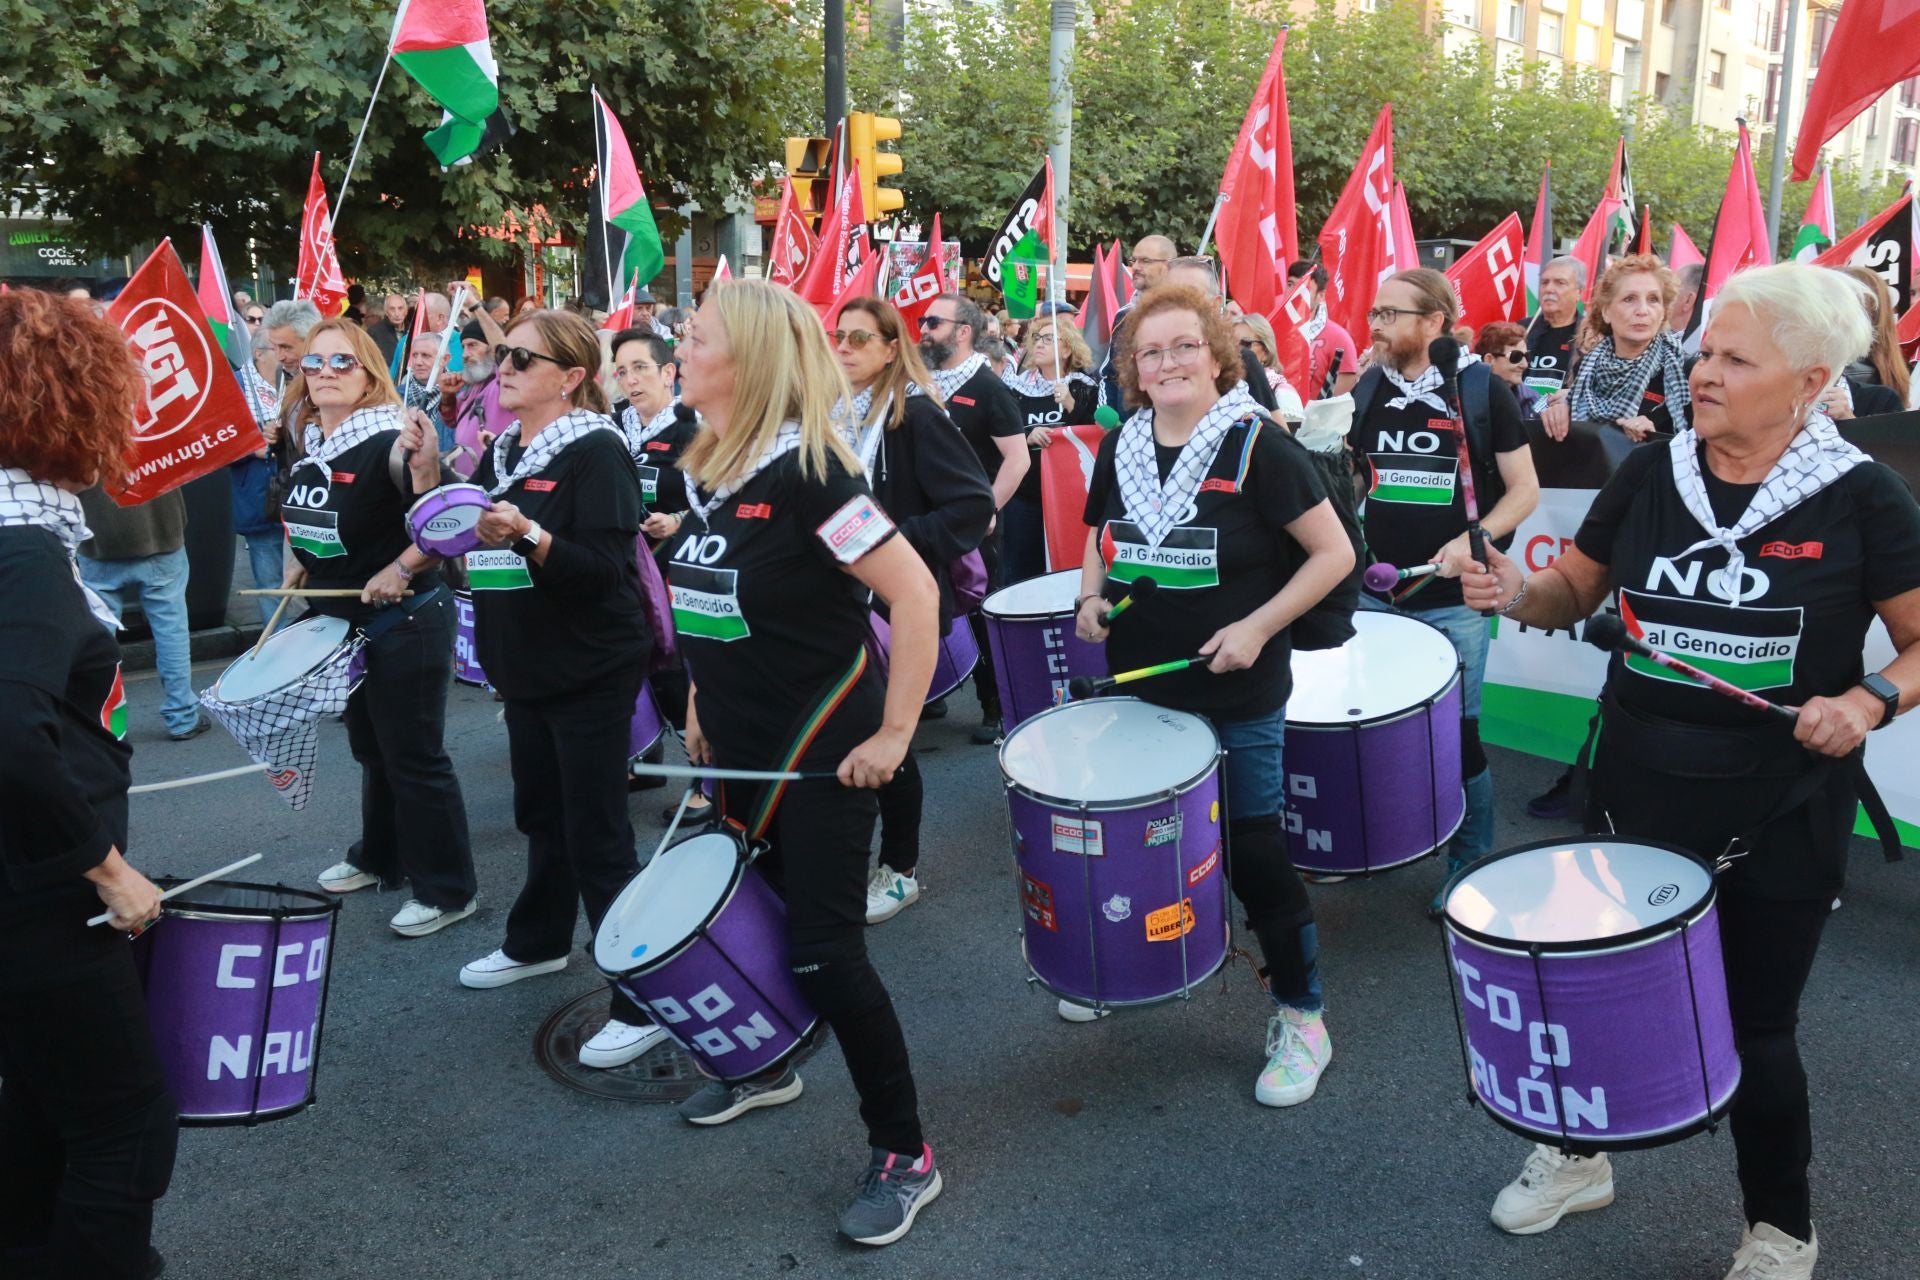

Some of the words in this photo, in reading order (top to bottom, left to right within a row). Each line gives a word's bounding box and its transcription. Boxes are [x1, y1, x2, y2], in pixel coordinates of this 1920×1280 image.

[832, 232, 849, 295] Estudiantes
[130, 309, 200, 423] UGT
[1027, 410, 1063, 425] NO
[1376, 430, 1441, 453] NO
[125, 424, 238, 486] www.ugt.es
[1390, 472, 1451, 486] Genocidio
[286, 484, 329, 508] NO
[468, 554, 475, 566] al
[478, 553, 522, 567] Genocidio
[673, 534, 727, 564] NO
[1120, 547, 1132, 559] al
[1763, 543, 1804, 556] CCOO
[1645, 556, 1770, 602] NO
[682, 592, 734, 613] Genocidio
[1648, 629, 1666, 646] al
[1673, 631, 1791, 659] Genocidio
[207, 1022, 317, 1081] NAL
